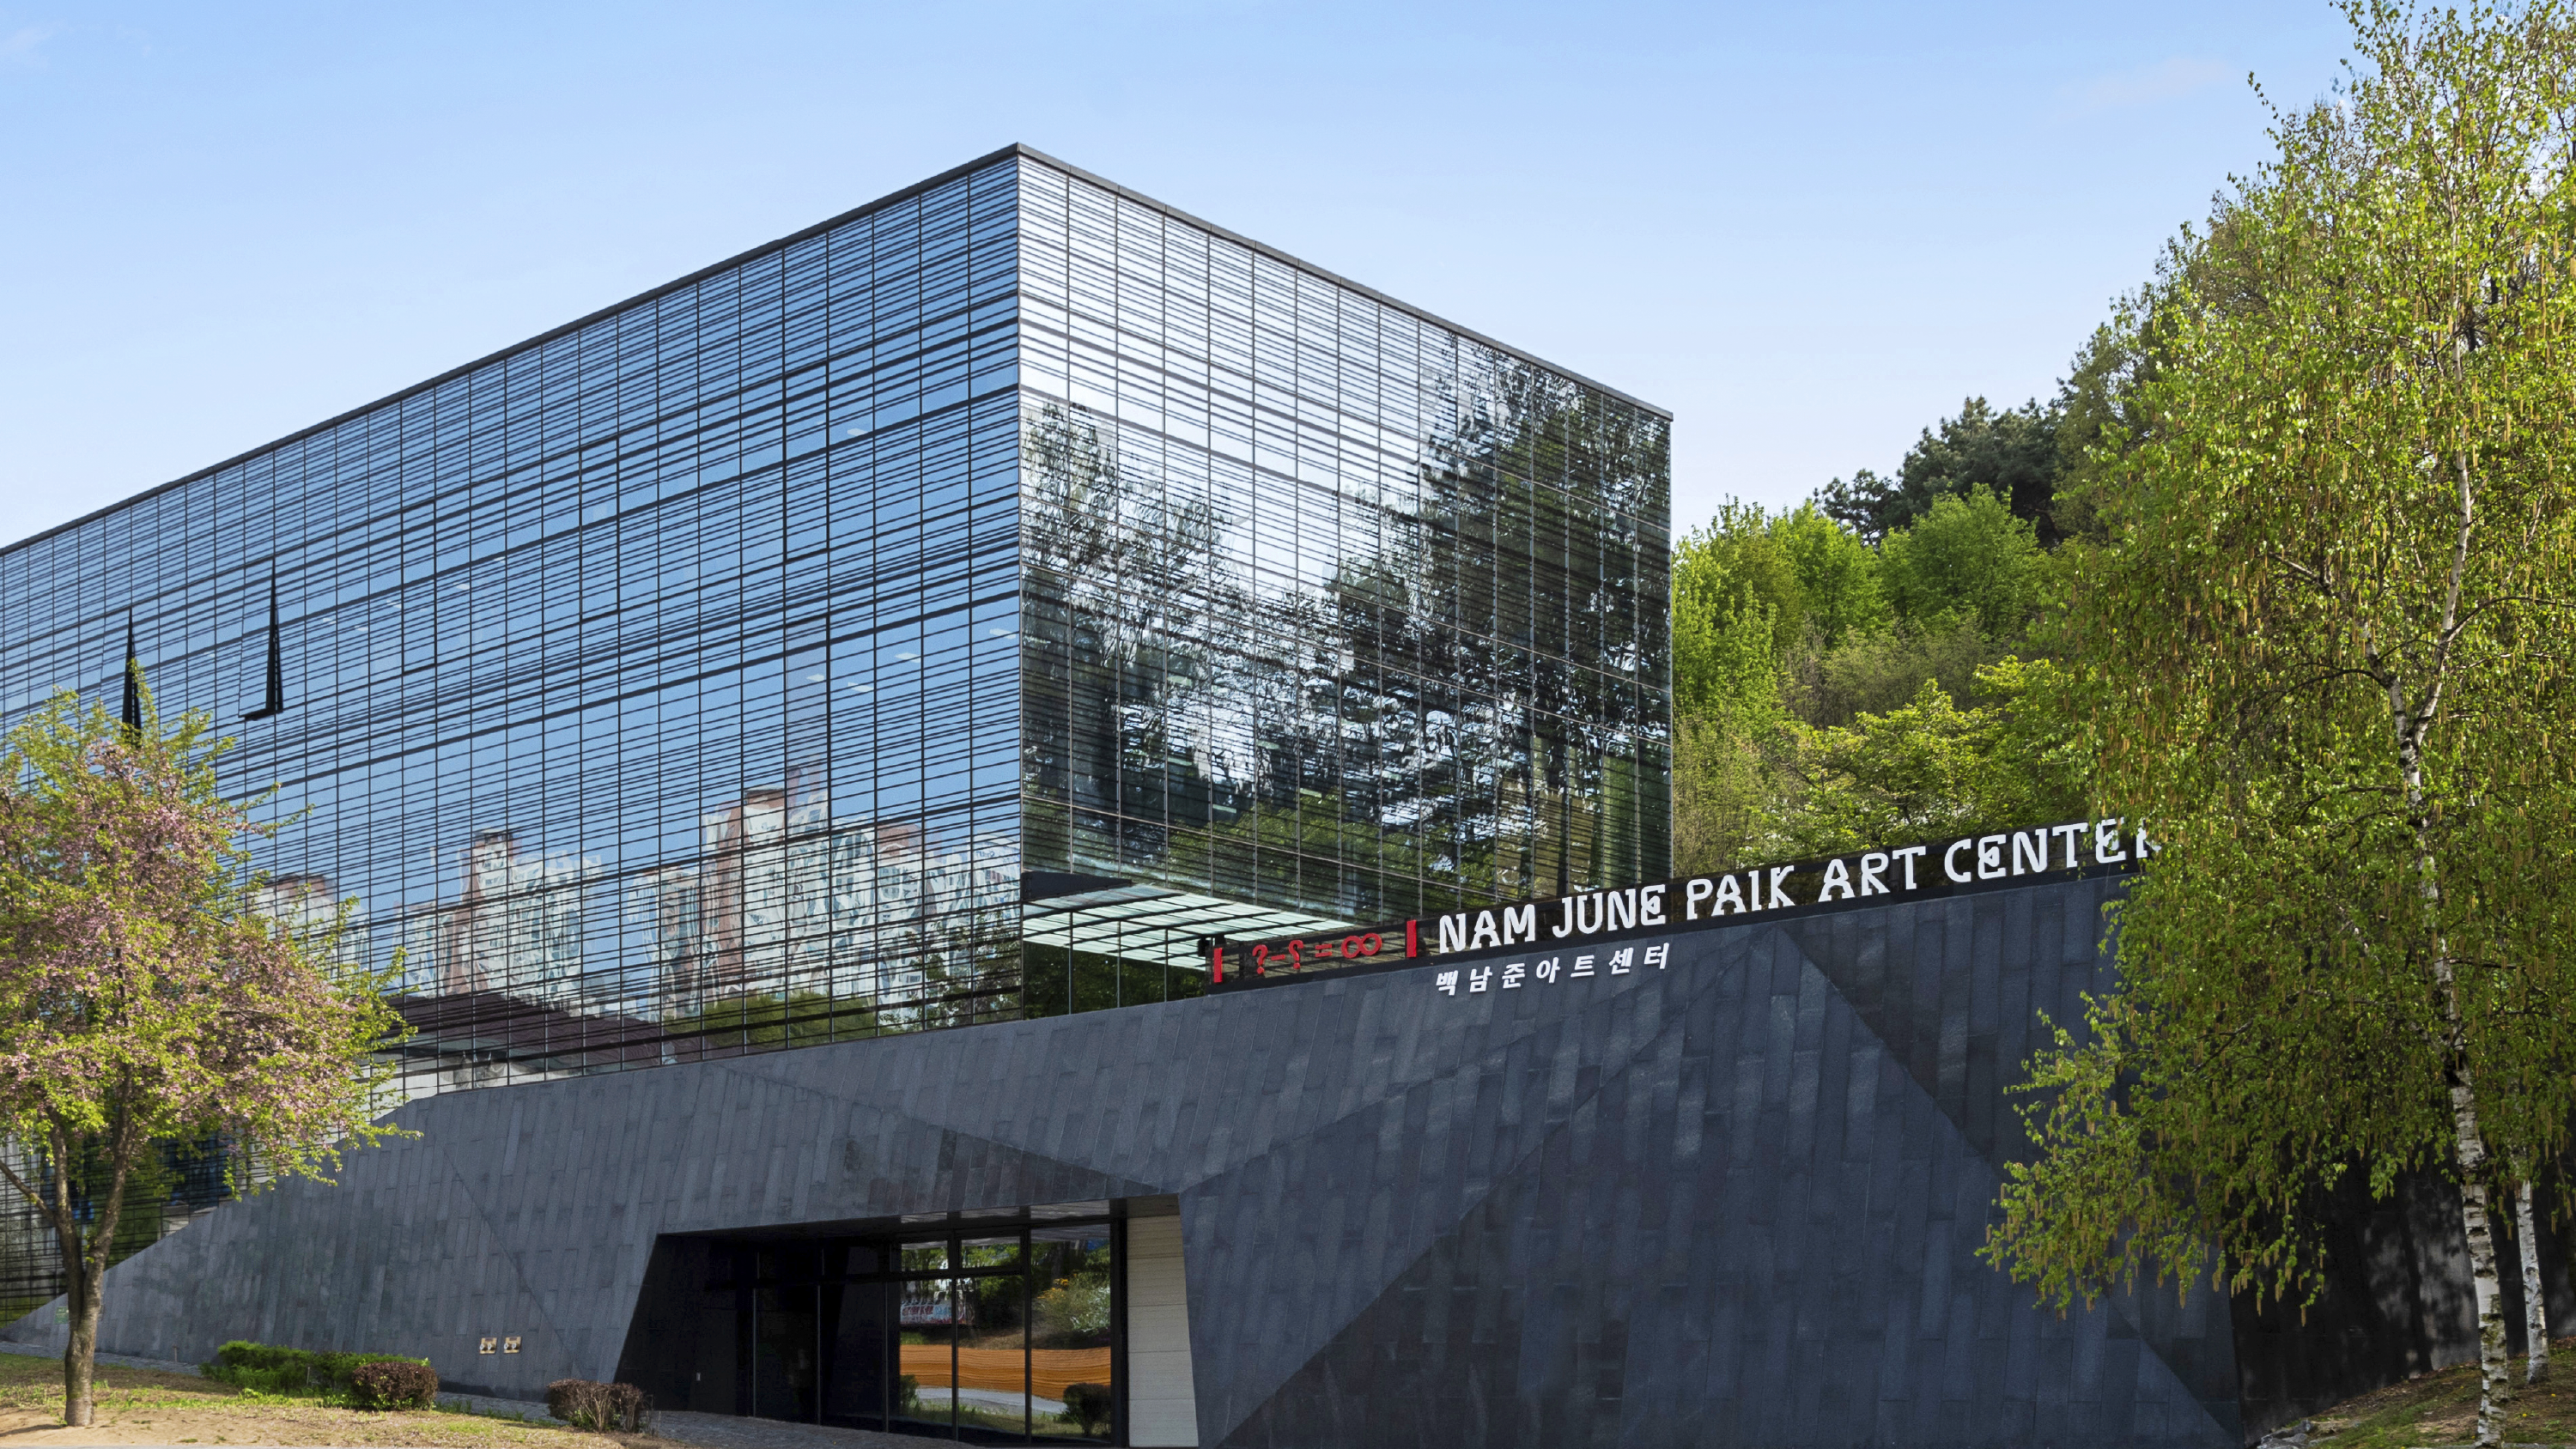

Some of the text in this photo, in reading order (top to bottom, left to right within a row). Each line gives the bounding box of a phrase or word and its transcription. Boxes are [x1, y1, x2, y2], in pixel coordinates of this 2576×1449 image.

[1438, 902, 1537, 955] NAM
[1551, 883, 1667, 939] JUNE
[1686, 864, 1796, 921] PAIK
[1817, 846, 1926, 903] ART
[1435, 941, 1671, 997] 백남준아트센터
